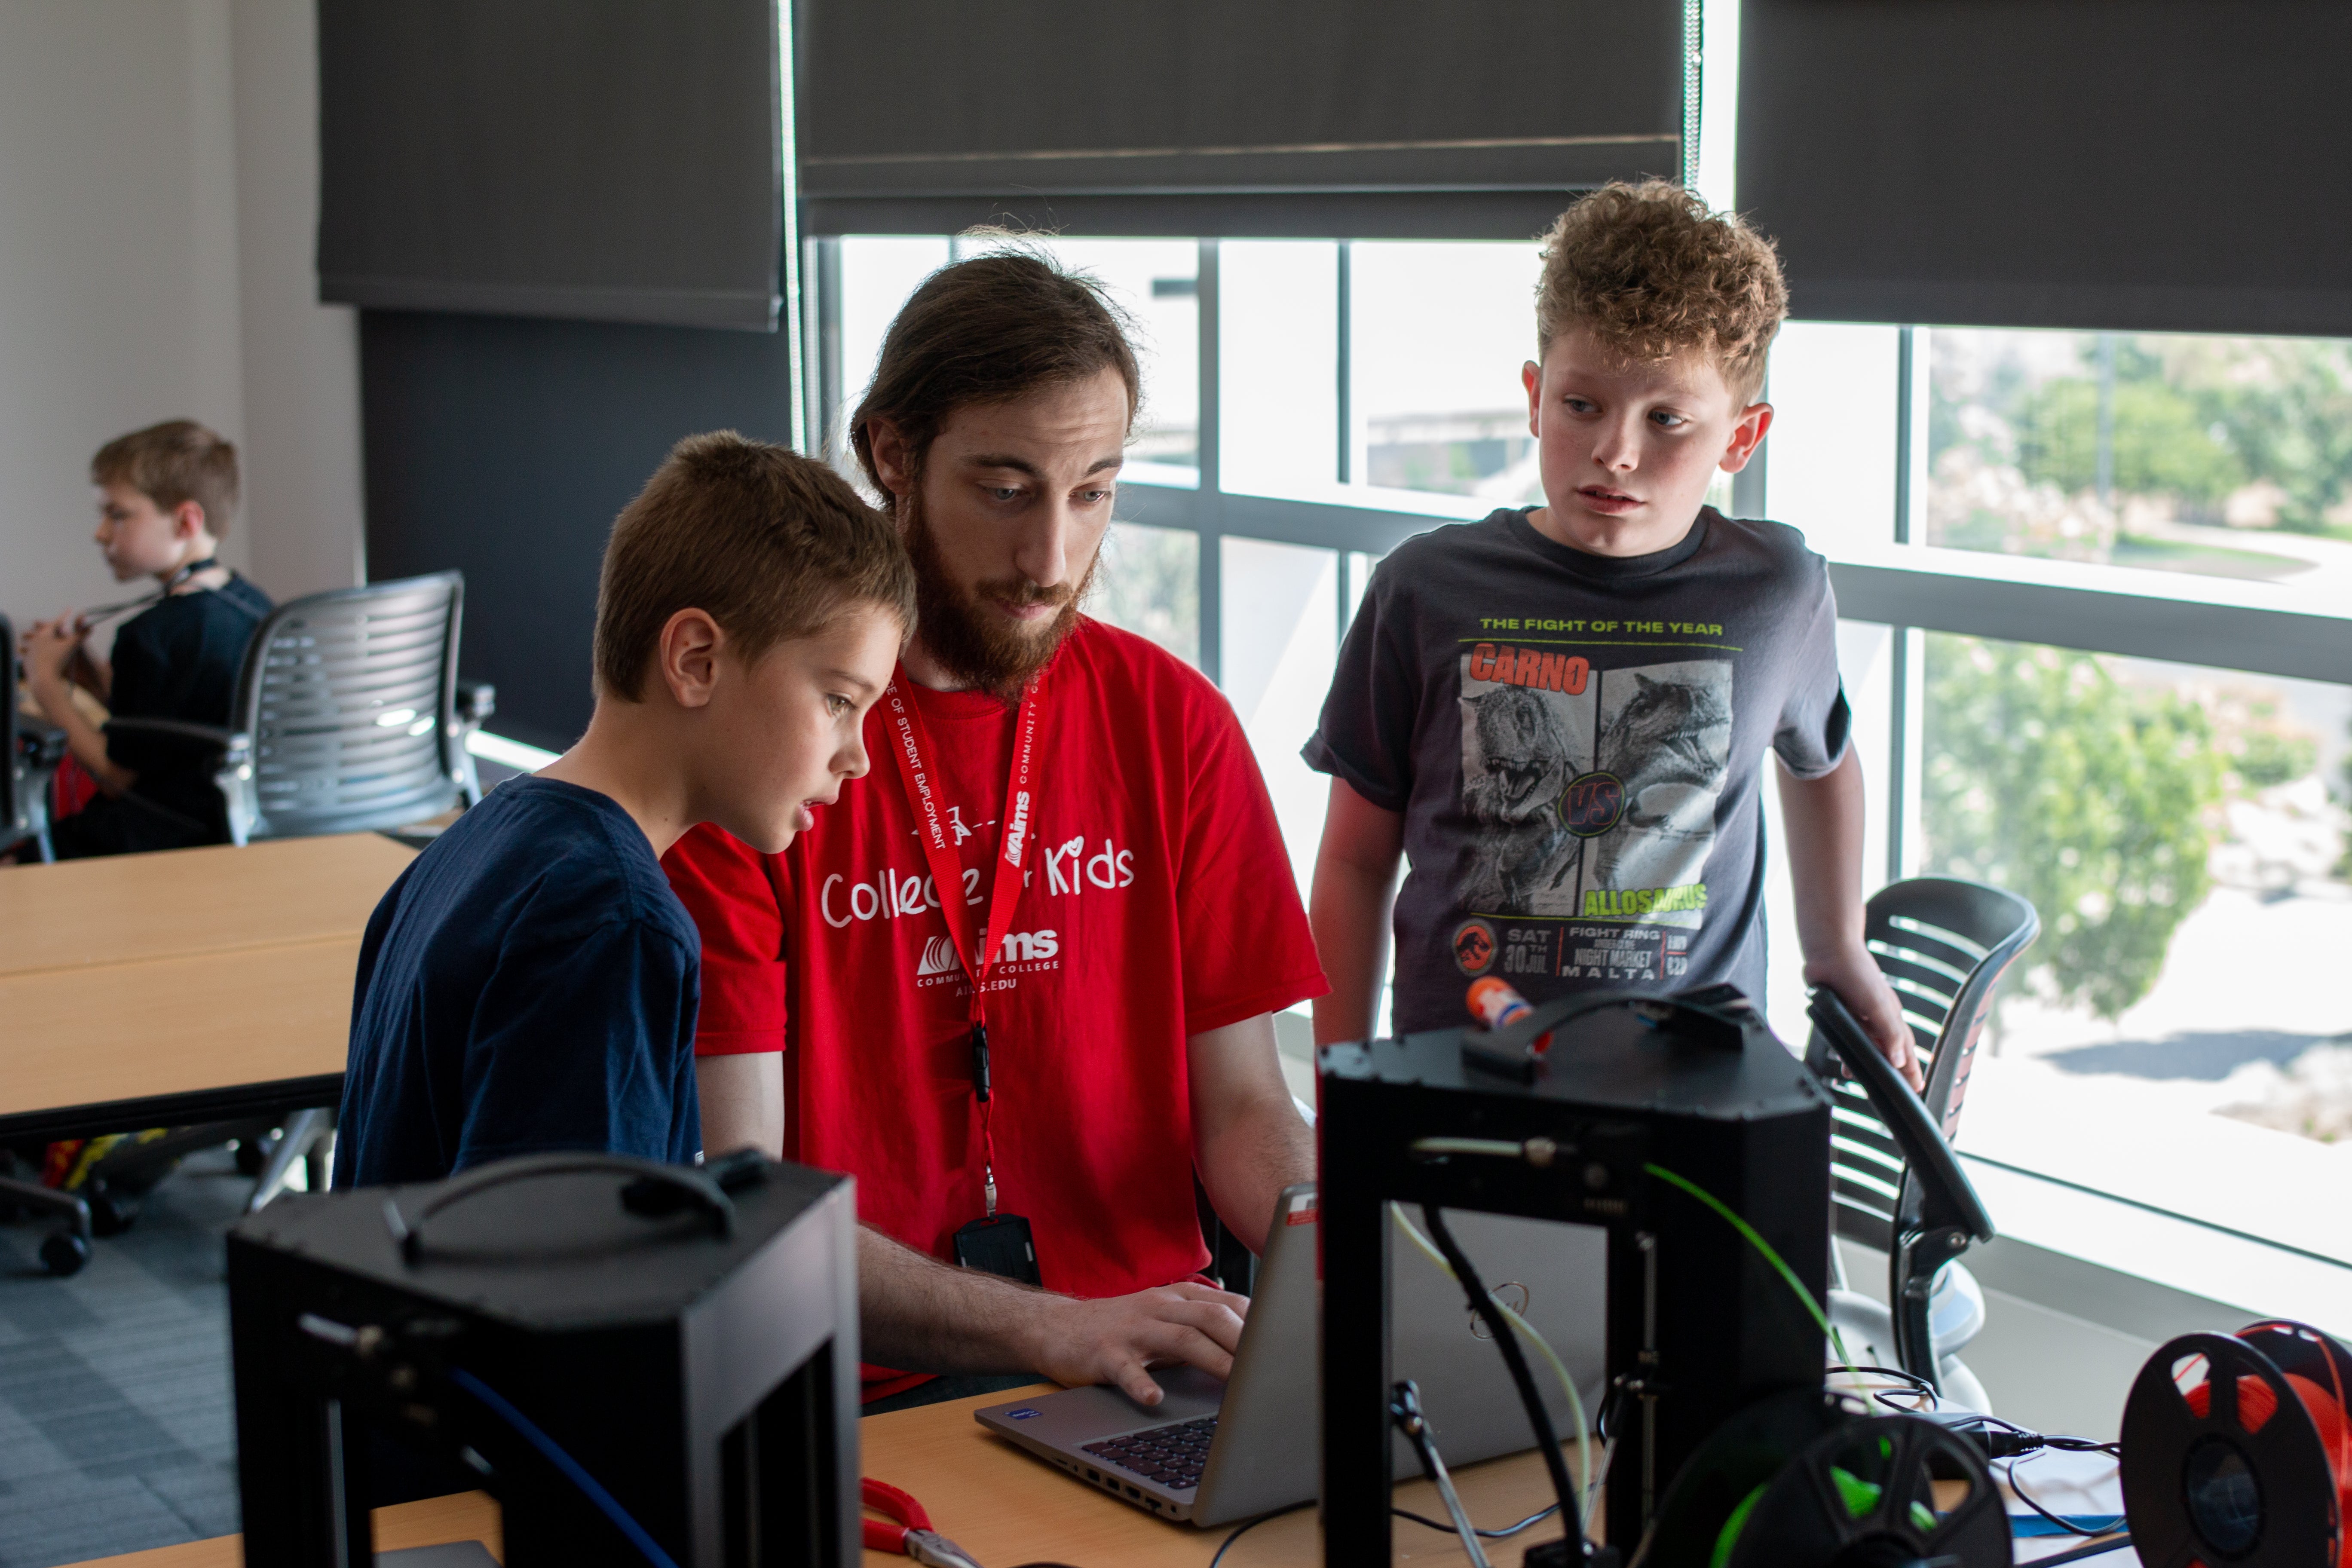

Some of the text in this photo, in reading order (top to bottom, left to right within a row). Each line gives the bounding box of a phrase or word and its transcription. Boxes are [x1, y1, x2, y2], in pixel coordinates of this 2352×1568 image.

[1480, 618, 1723, 636] THE FIGHT OF THE YEAR
[1470, 643, 1589, 695] CARNO
[891, 698, 904, 714] OF
[897, 717, 922, 769] STUDENT
[1008, 790, 1030, 850] Aims
[1020, 701, 1037, 784] COMMUNITY
[914, 772, 946, 849] EMPLOYMENT
[1566, 781, 1621, 826] VS
[1044, 836, 1135, 897] Kids
[1583, 883, 1708, 917] ALLOSAURUS
[1507, 928, 1551, 943] SAT
[1569, 927, 1660, 940] FIGHT RING
[999, 961, 1059, 974] COLLEGE
[1574, 948, 1652, 968] NIGHT MARKET
